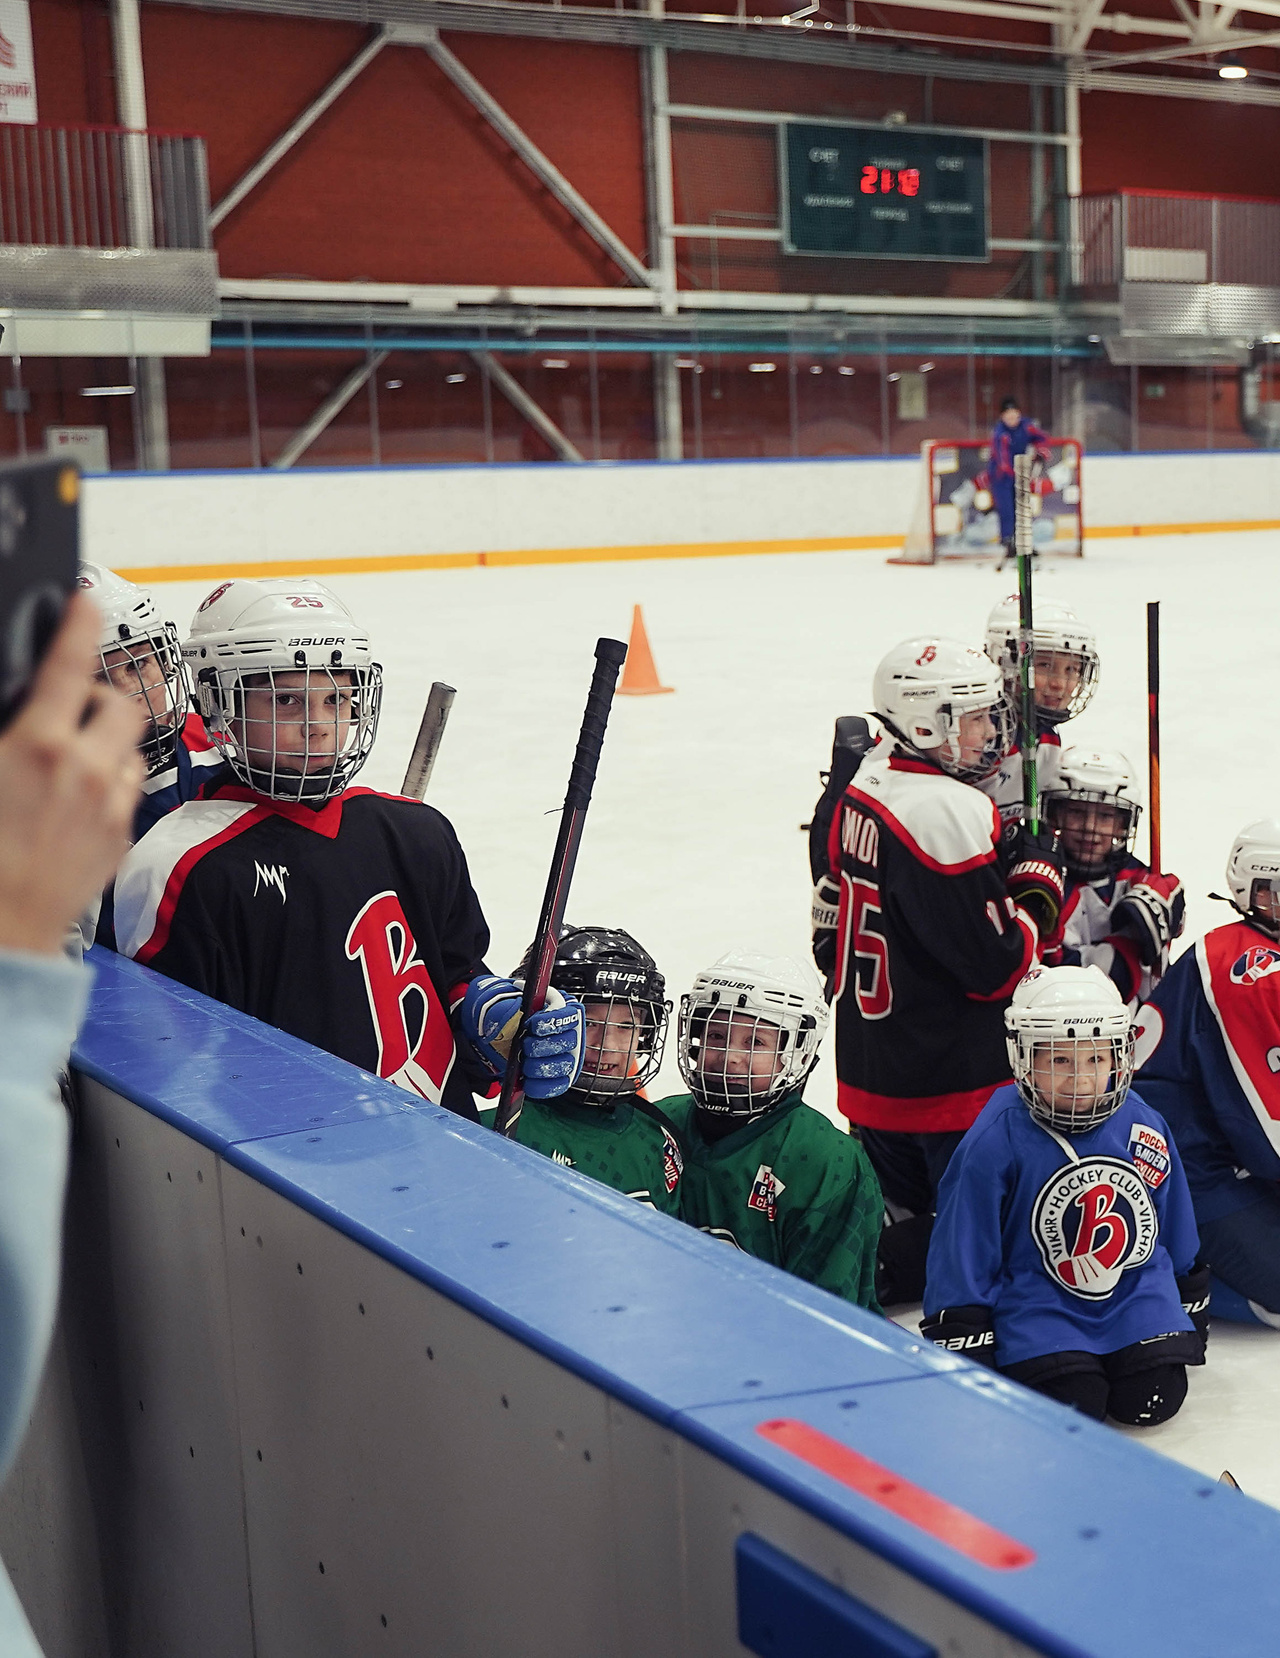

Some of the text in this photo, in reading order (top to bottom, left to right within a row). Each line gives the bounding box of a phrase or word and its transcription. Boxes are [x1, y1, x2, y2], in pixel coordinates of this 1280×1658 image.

[286, 596, 324, 608] 25
[288, 637, 346, 647] BAUER
[1251, 864, 1280, 872] CCM
[595, 970, 647, 984] BAUER
[710, 978, 756, 992] BAUER
[1063, 1016, 1104, 1025] BAUER
[1050, 1169, 1142, 1209] HOCKEY CLUB
[1045, 1217, 1062, 1260] VIKHR
[1135, 1207, 1152, 1257] VIKHR
